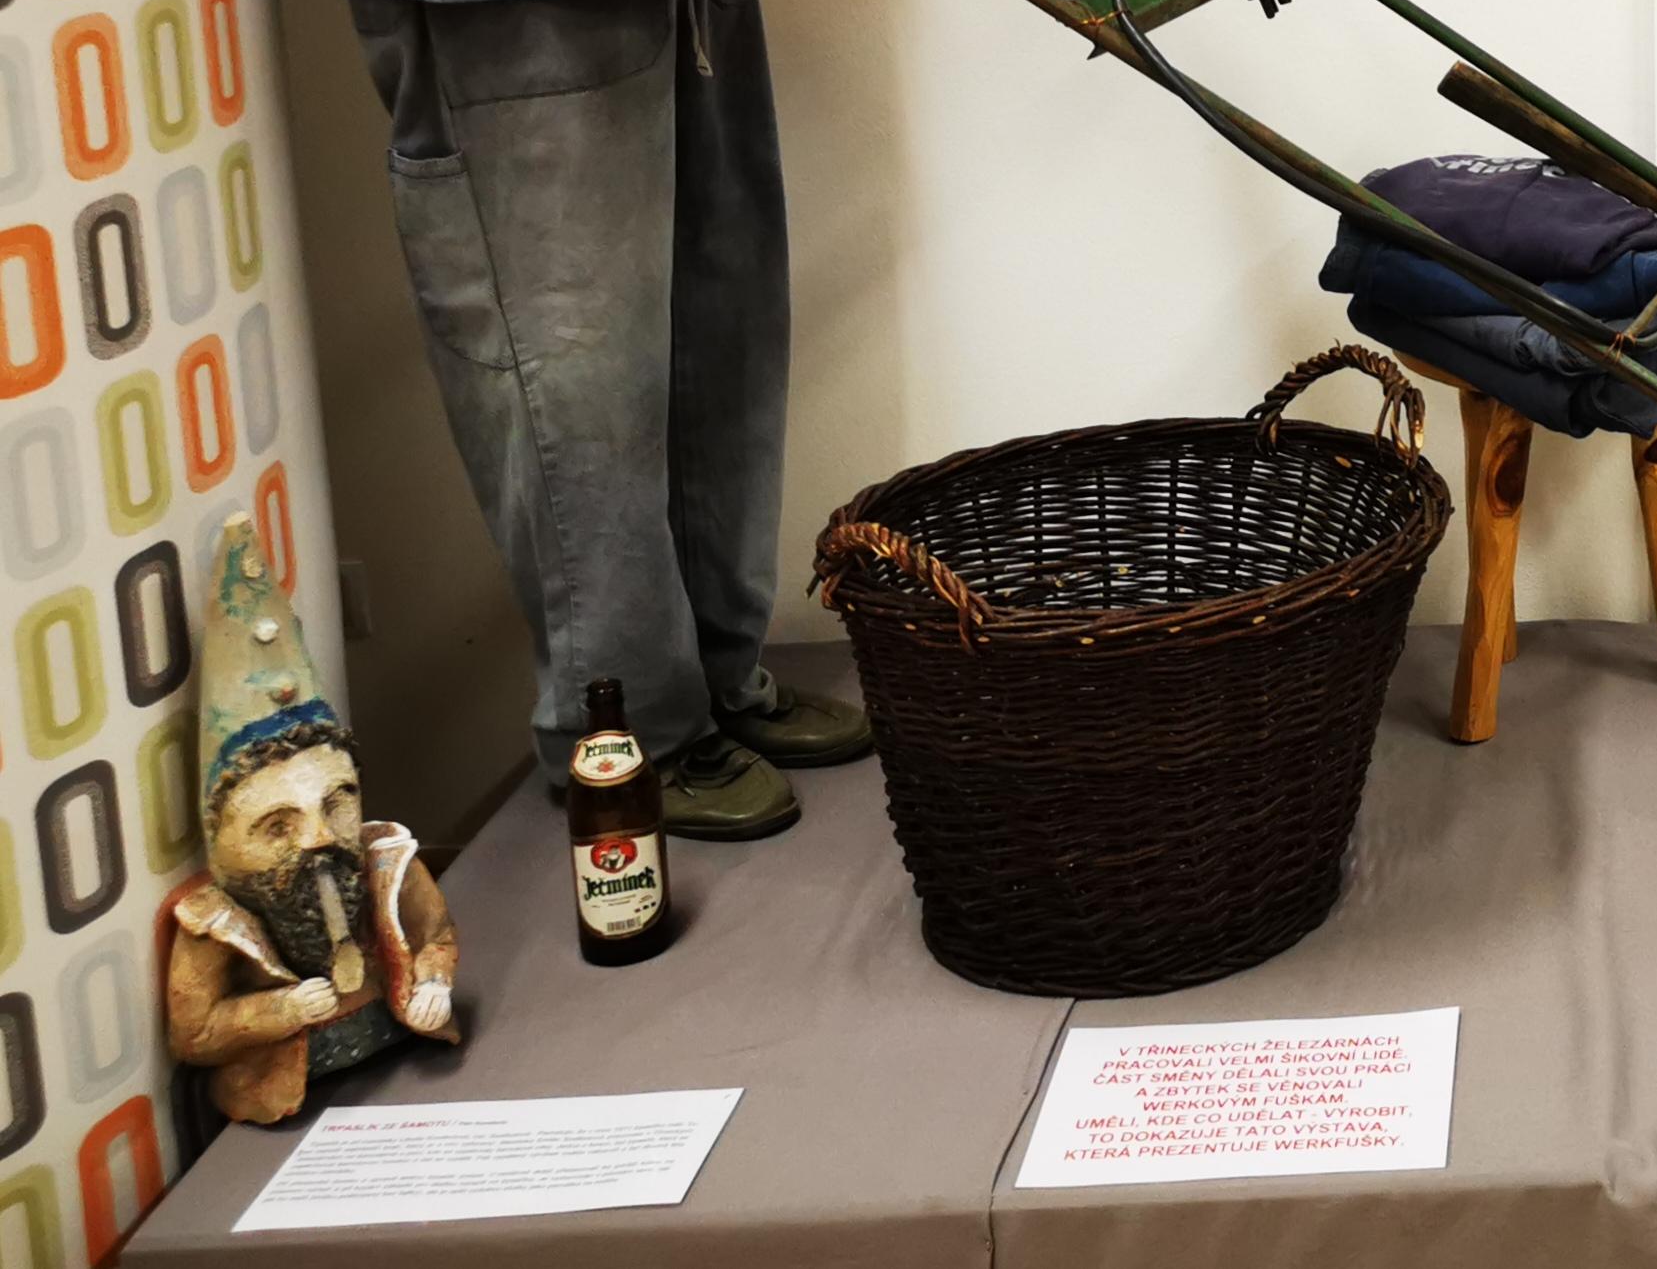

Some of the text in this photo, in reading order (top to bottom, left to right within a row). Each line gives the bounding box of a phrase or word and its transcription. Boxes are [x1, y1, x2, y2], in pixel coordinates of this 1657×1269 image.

[1119, 1046, 1131, 1057] V
[1137, 1041, 1256, 1057] TŘINECKÝCH
[1103, 1057, 1213, 1071] PRACOVALI
[1219, 1054, 1274, 1067] VELMI
[1281, 1050, 1356, 1064] ŠIKOVNÍ
[1093, 1072, 1144, 1085] ČÁST
[1150, 1070, 1217, 1082] SMĚNY
[1222, 1067, 1290, 1080] DĚLALI
[1296, 1065, 1348, 1077] SVOU
[1135, 1079, 1363, 1097] A ZBYTEK SE VĚNOVALI
[1143, 1095, 1257, 1111] WERKOVÝM
[1147, 1114, 1187, 1127] KDE
[1194, 1112, 1222, 1124] CO
[1227, 1109, 1306, 1122] UDĚLAT
[1089, 1132, 1114, 1144] TO
[1120, 1126, 1228, 1143] DOKAZUJE
[1235, 1124, 1287, 1137] TATO
[1064, 1146, 1131, 1161] KTERÁ
[1138, 1140, 1268, 1158] PREZENTUJE
